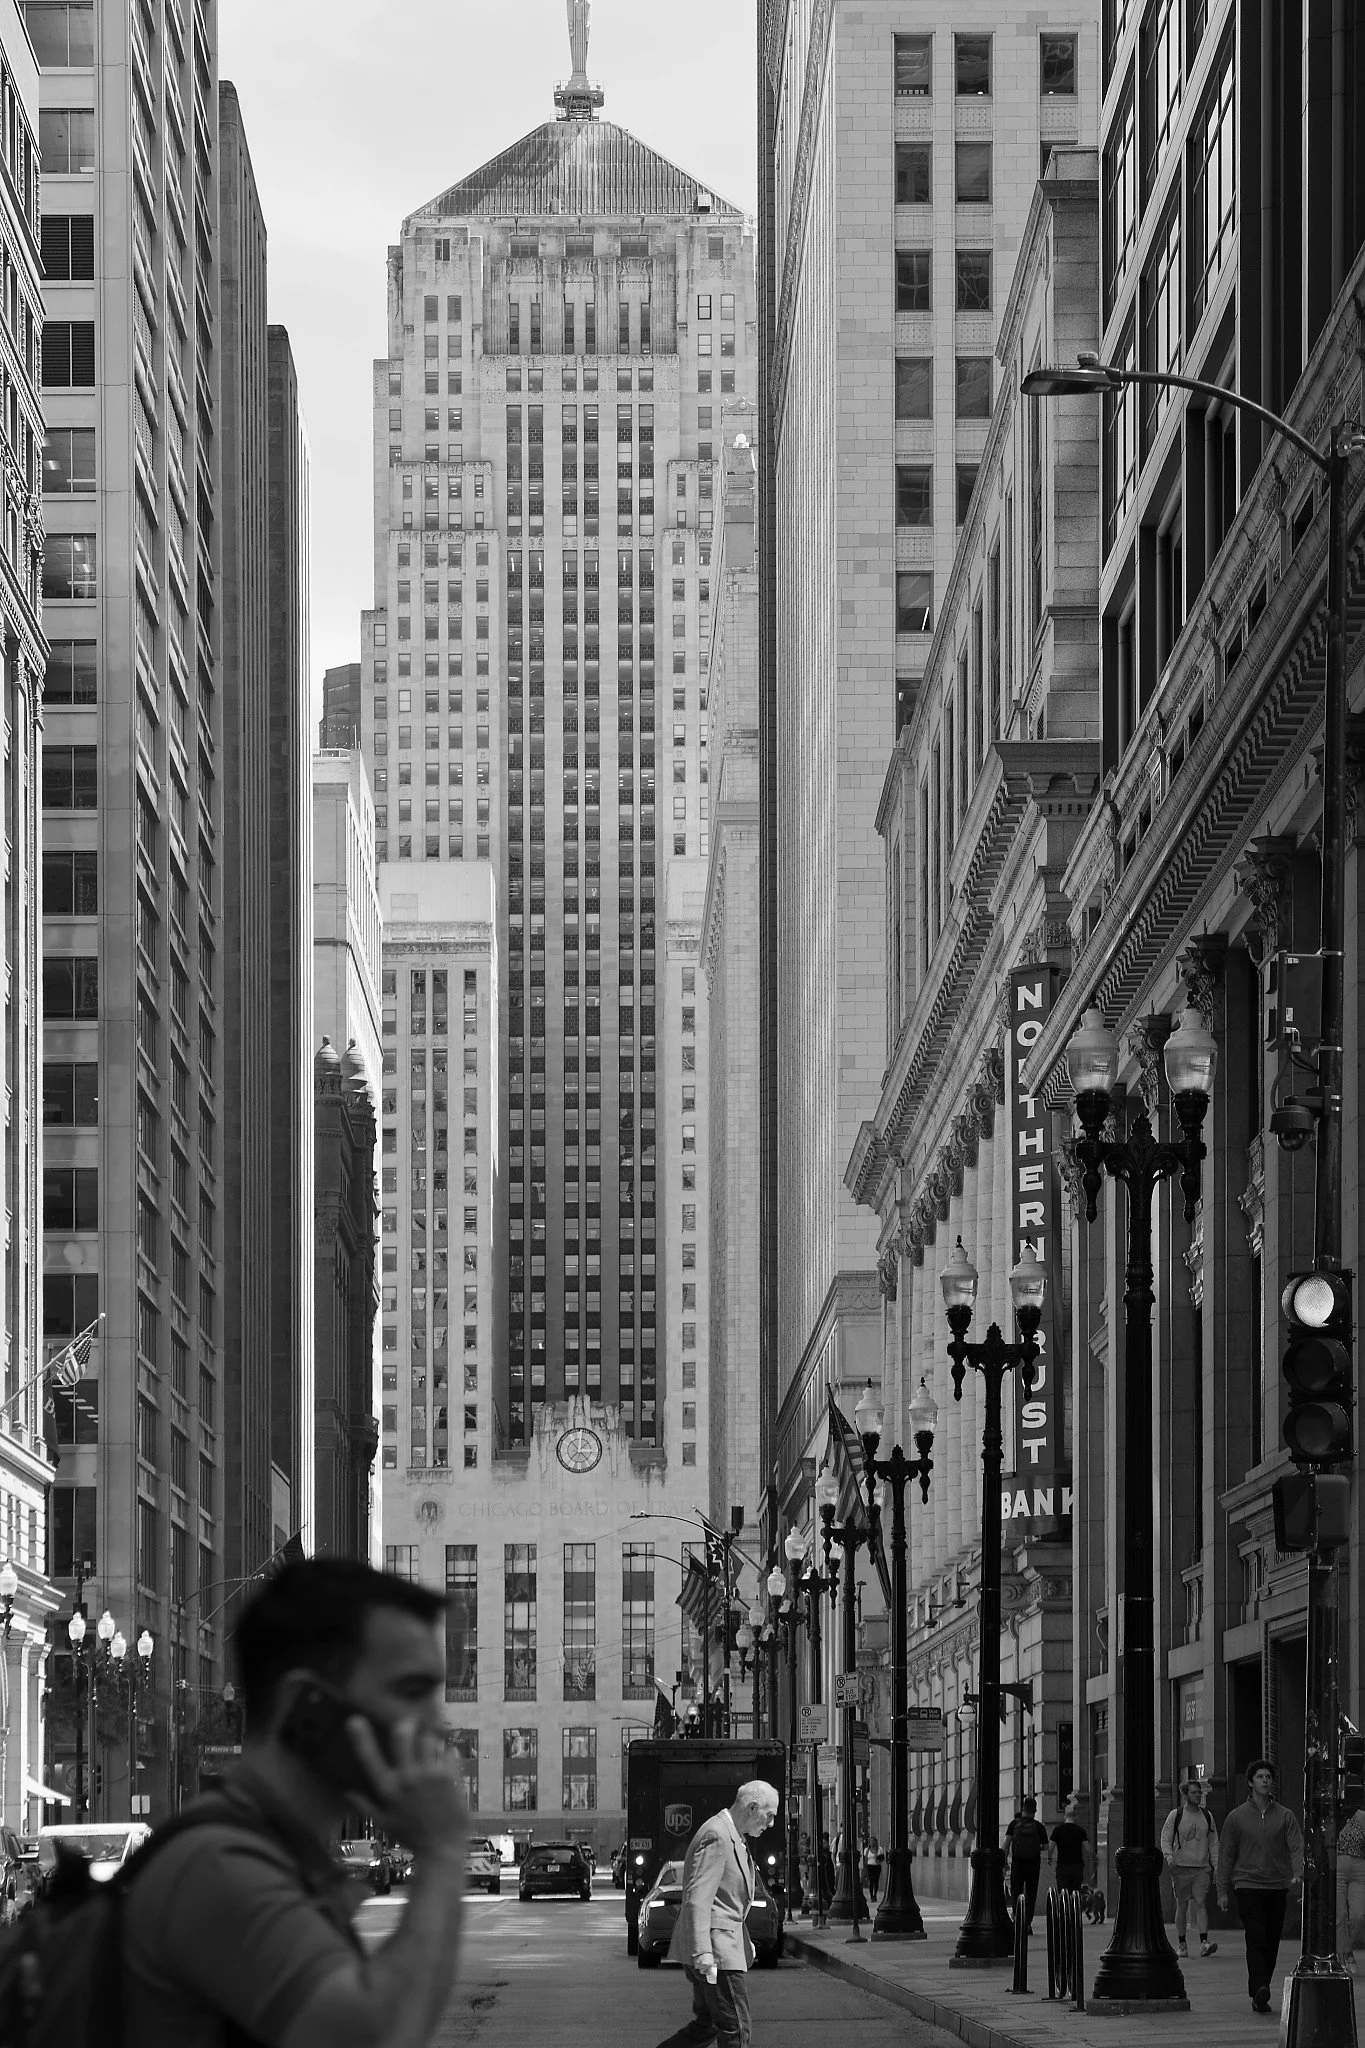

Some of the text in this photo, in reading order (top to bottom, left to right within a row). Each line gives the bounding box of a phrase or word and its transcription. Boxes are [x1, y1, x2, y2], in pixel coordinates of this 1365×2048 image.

[1017, 982, 1047, 1464] NOTHERN RUST
[459, 1502, 541, 1517] CHICAGO
[549, 1501, 608, 1516] BOARD
[617, 1501, 636, 1514] OF
[1001, 1487, 1074, 1520] BANK
[667, 1814, 691, 1832] ups
